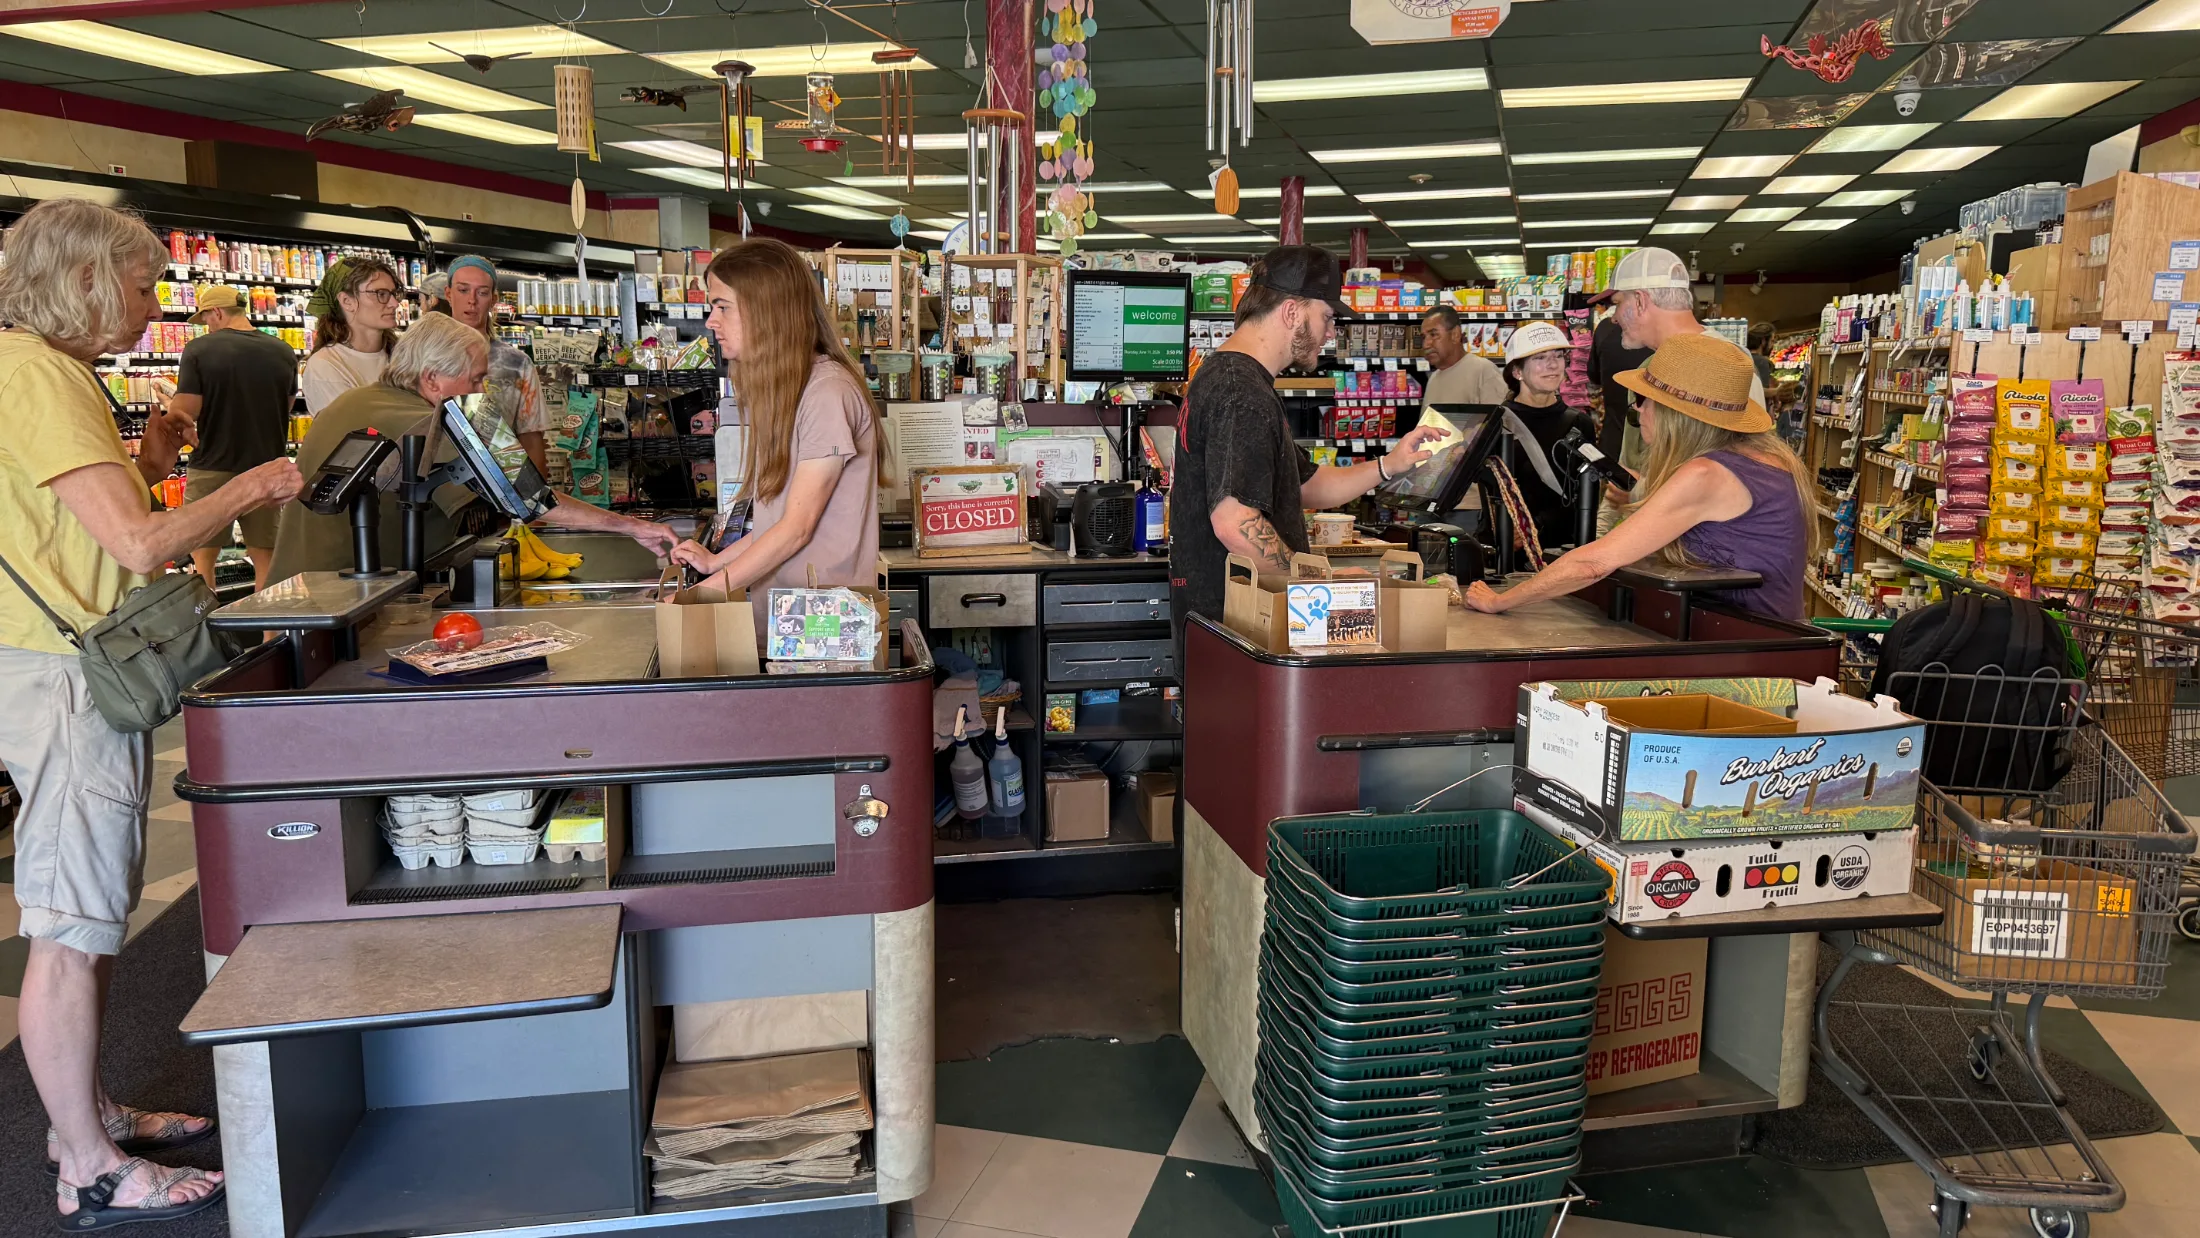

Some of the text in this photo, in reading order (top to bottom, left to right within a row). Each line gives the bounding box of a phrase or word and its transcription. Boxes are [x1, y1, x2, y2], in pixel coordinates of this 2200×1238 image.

[1392, 0, 1468, 17] GROCERY
[1132, 310, 1177, 320] welcome
[561, 352, 581, 360] JERKY
[2004, 390, 2046, 401] Ricola
[2060, 394, 2097, 402] Ricola
[964, 427, 989, 435] NTED
[2115, 442, 2135, 450] Throat
[926, 504, 947, 512] Sorry,
[948, 502, 960, 510] this
[961, 501, 976, 509] lane
[983, 498, 1014, 507] currently
[926, 507, 1015, 532] CLOSED
[1643, 744, 1682, 755] PRODUCE
[1643, 755, 1680, 764] OF U.S.A.
[1721, 738, 1825, 784] Burkart
[1760, 753, 1865, 800] Organics
[277, 825, 314, 836] KILLION
[1561, 827, 1577, 841] Tutti
[1701, 827, 1736, 835] ORGANICALLY
[1748, 852, 1778, 865] Tutti
[1839, 856, 1862, 867] USDA
[1655, 863, 1690, 878] SPECIALTY
[1835, 868, 1865, 879] ORGANIC
[1646, 879, 1697, 894] ORGANIC
[1762, 885, 1798, 899] Frutti
[1658, 897, 1684, 907] CROPS
[1628, 911, 1640, 919] 1988
[1594, 972, 1692, 1036] EGGS
[1585, 1032, 1699, 1082] EEP REFRIGERATED
